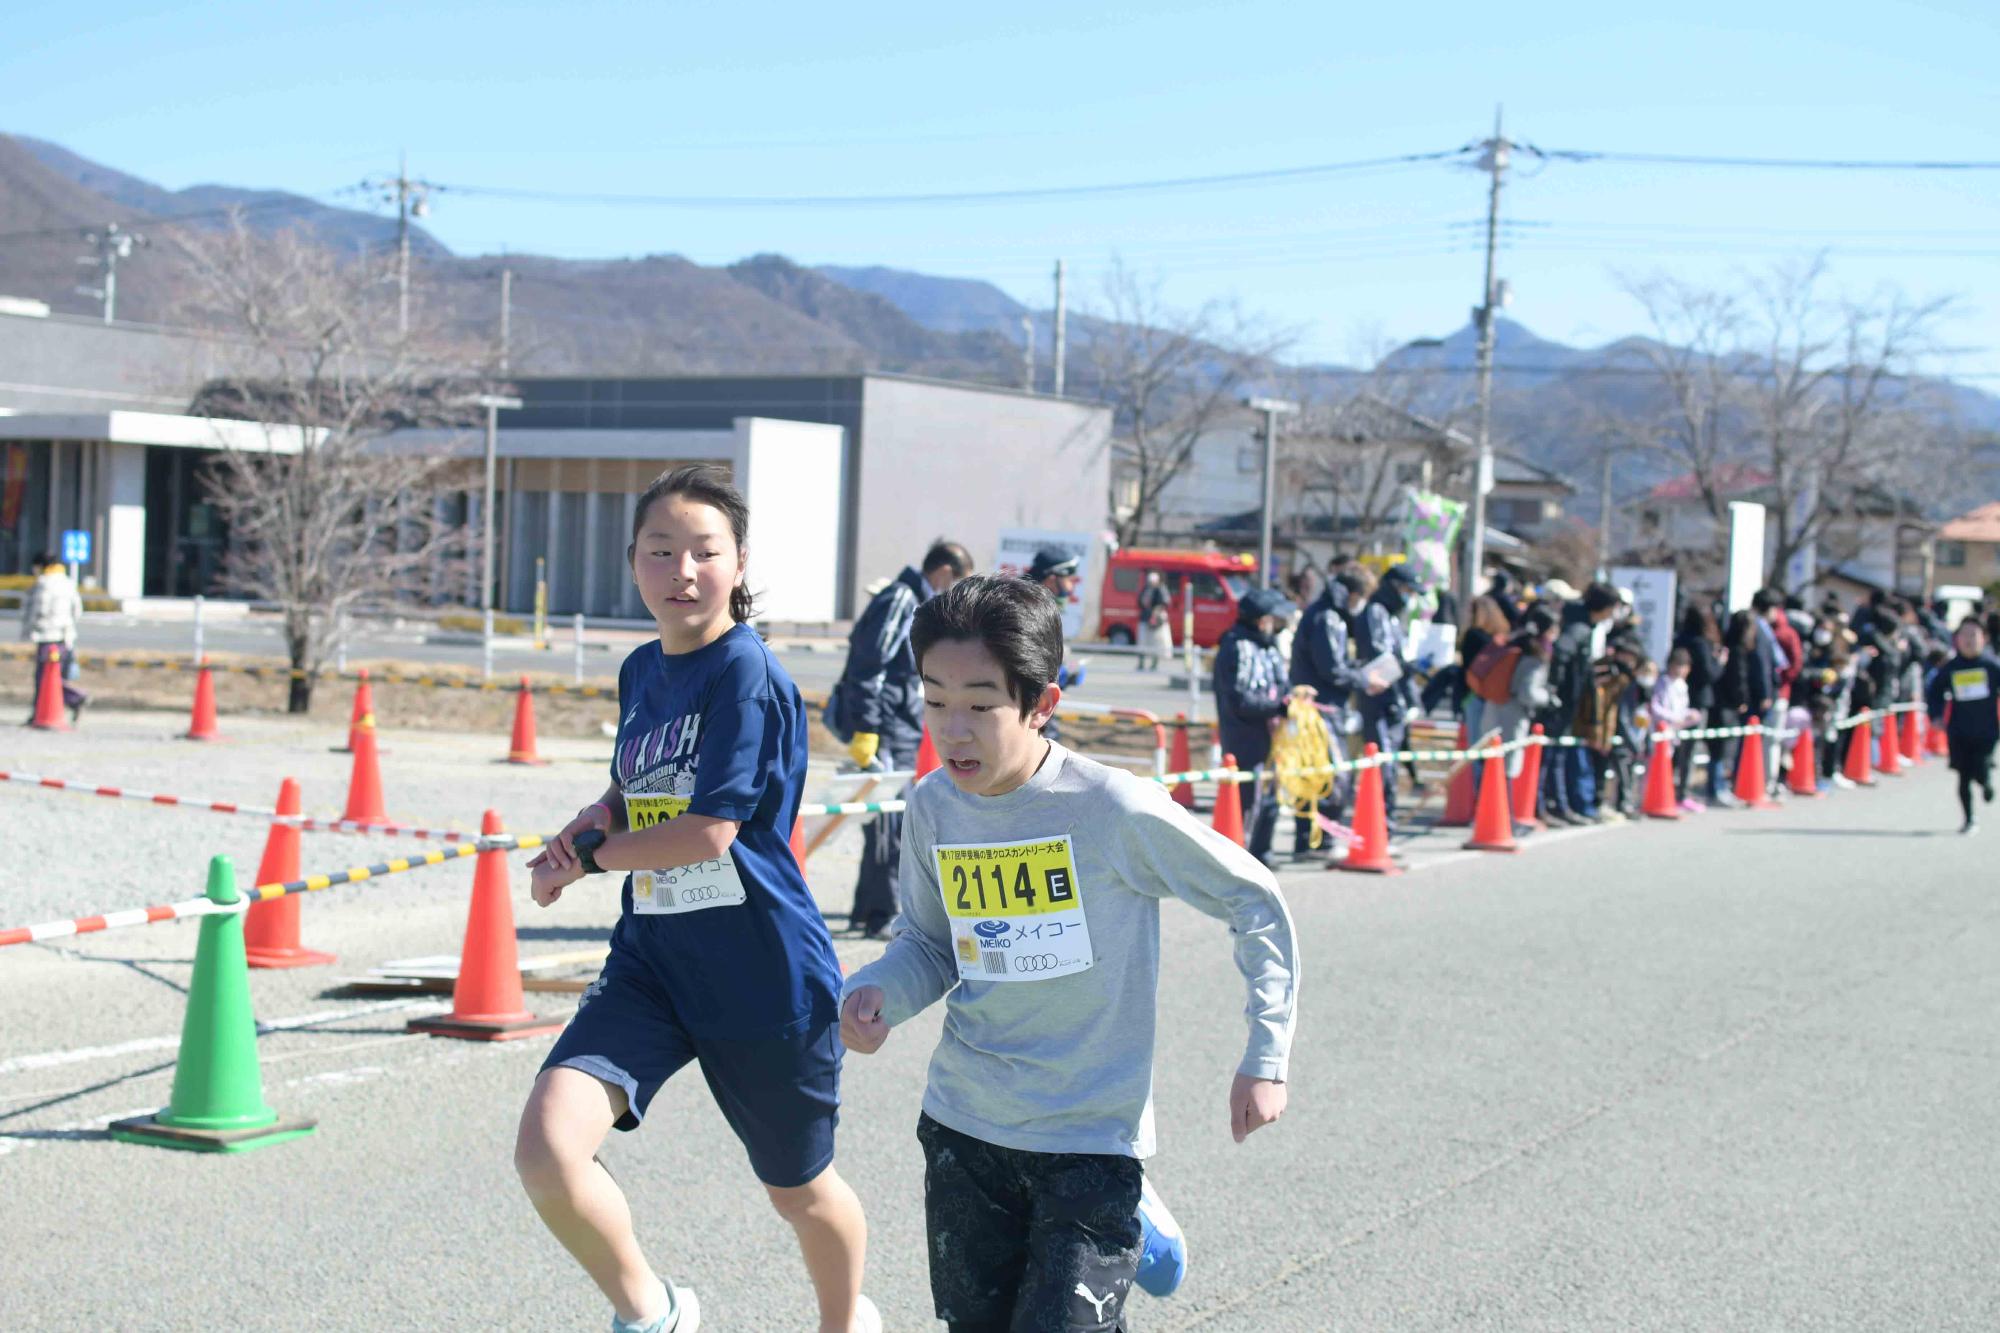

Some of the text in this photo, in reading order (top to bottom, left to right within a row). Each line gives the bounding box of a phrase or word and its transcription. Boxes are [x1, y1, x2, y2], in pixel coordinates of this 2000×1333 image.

[952, 862, 1069, 910] 2114 E
[1015, 922, 1081, 941] メイコー
[980, 938, 1011, 948] MEIKO
